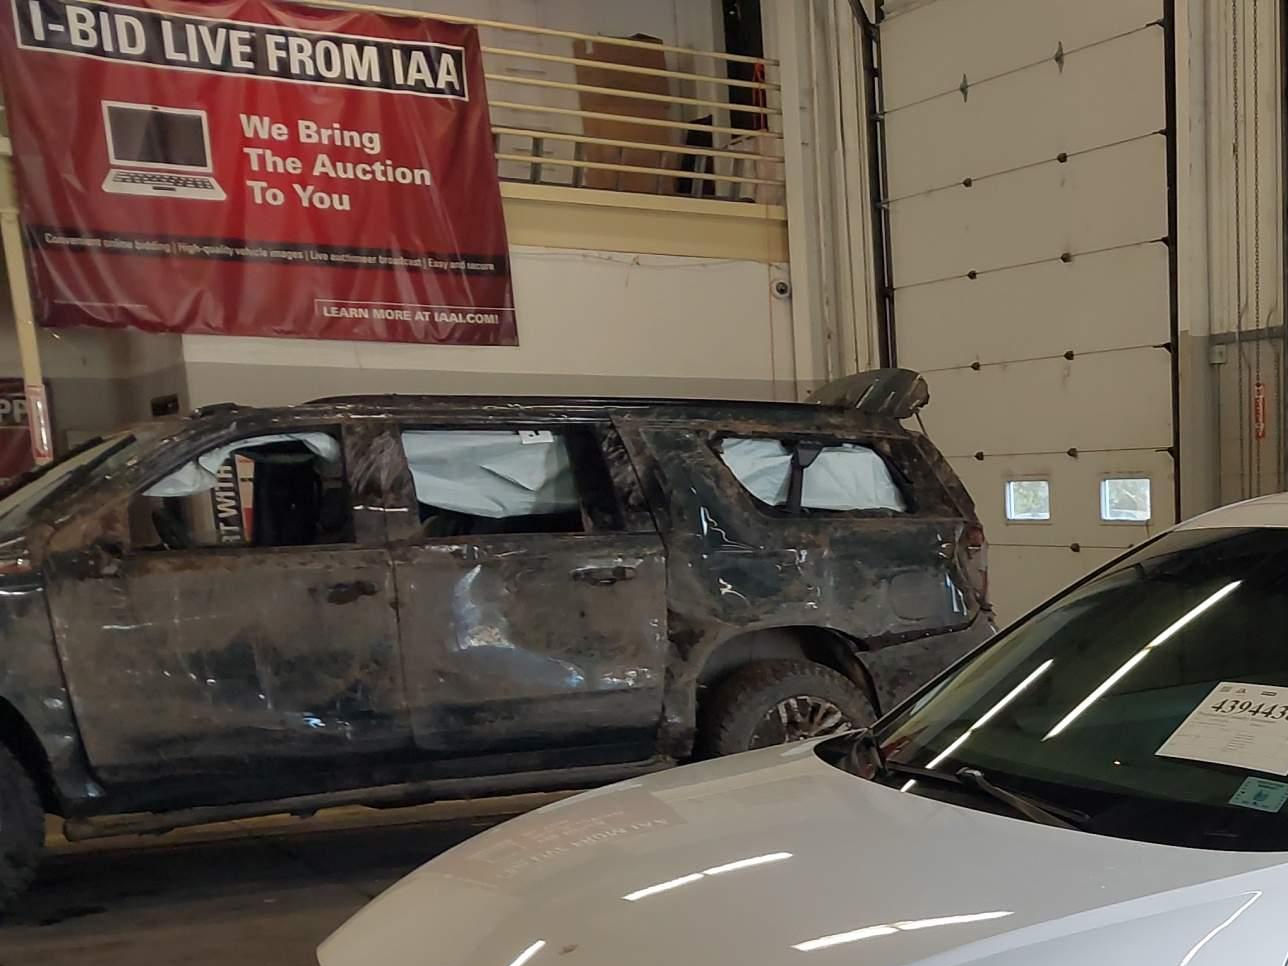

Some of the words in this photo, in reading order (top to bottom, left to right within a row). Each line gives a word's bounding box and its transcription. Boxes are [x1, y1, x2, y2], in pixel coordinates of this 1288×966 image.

[28, 0, 146, 55] I-BID
[162, 20, 255, 69] LIVE
[265, 34, 381, 82] FROM
[392, 48, 460, 90] IAA
[239, 113, 288, 141] We
[298, 119, 381, 154] Bring
[243, 147, 302, 174] The
[312, 153, 431, 185] Auction
[246, 181, 284, 205] To
[293, 183, 350, 210] You
[323, 306, 368, 319] LEARN
[372, 308, 411, 321] MORE
[415, 310, 430, 321] AT
